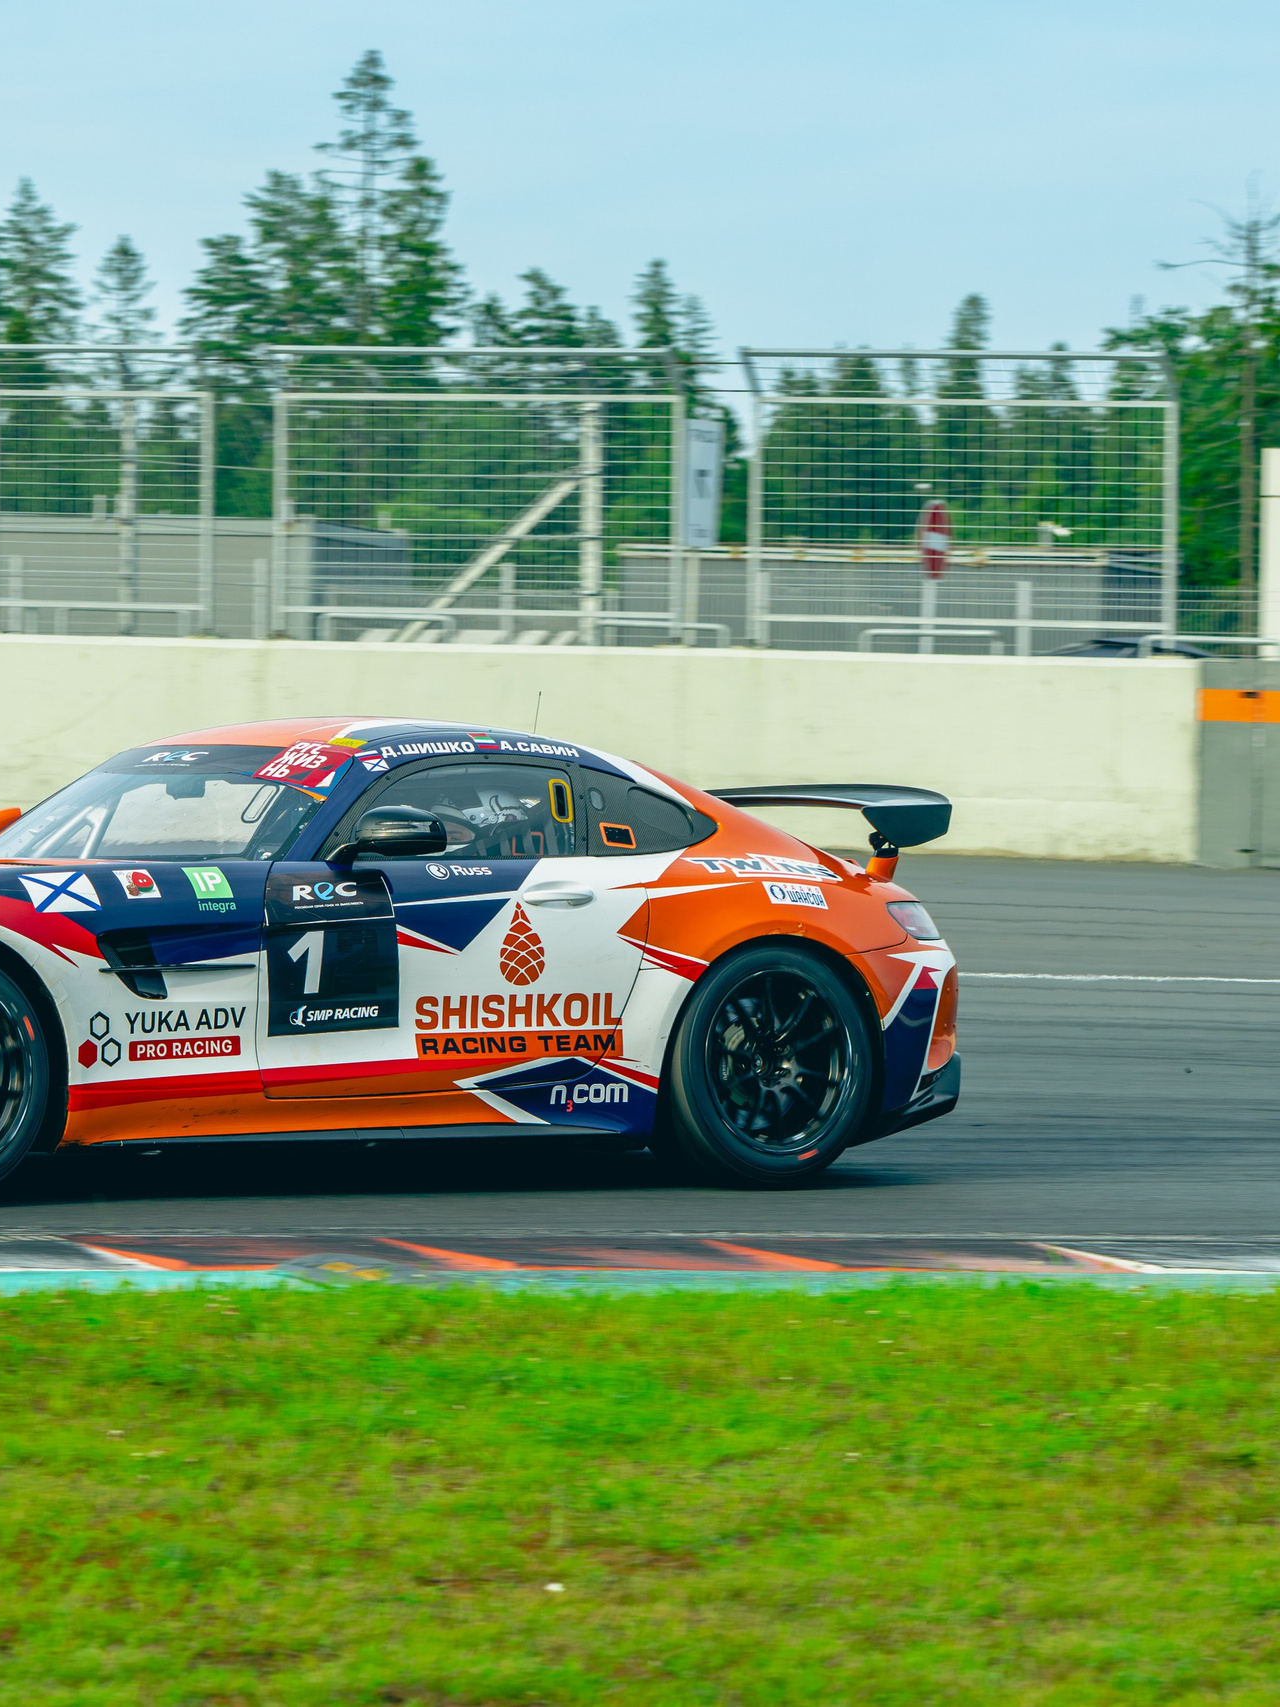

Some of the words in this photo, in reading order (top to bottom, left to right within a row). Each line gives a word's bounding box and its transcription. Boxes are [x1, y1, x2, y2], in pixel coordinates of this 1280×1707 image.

[287, 741, 332, 755] РГС
[380, 741, 476, 759] Д.ШИШКО
[500, 740, 580, 757] А.САВИН
[273, 751, 328, 769] ЖИЗ
[258, 762, 291, 778] НЬ
[449, 865, 493, 876] Russ
[192, 871, 222, 892] IP
[198, 901, 237, 913] integra
[786, 890, 826, 907] ШАНСОН
[287, 930, 325, 994] 1
[125, 1009, 191, 1034] YUKA
[194, 1006, 247, 1031] ADV
[306, 1010, 333, 1022] SMP
[334, 1006, 379, 1020] RACING
[414, 993, 623, 1030] SHISHKOIL
[136, 1043, 167, 1059] PRO
[172, 1039, 233, 1057] RACING
[421, 1036, 527, 1055] RACING
[538, 1034, 616, 1052] TEAM
